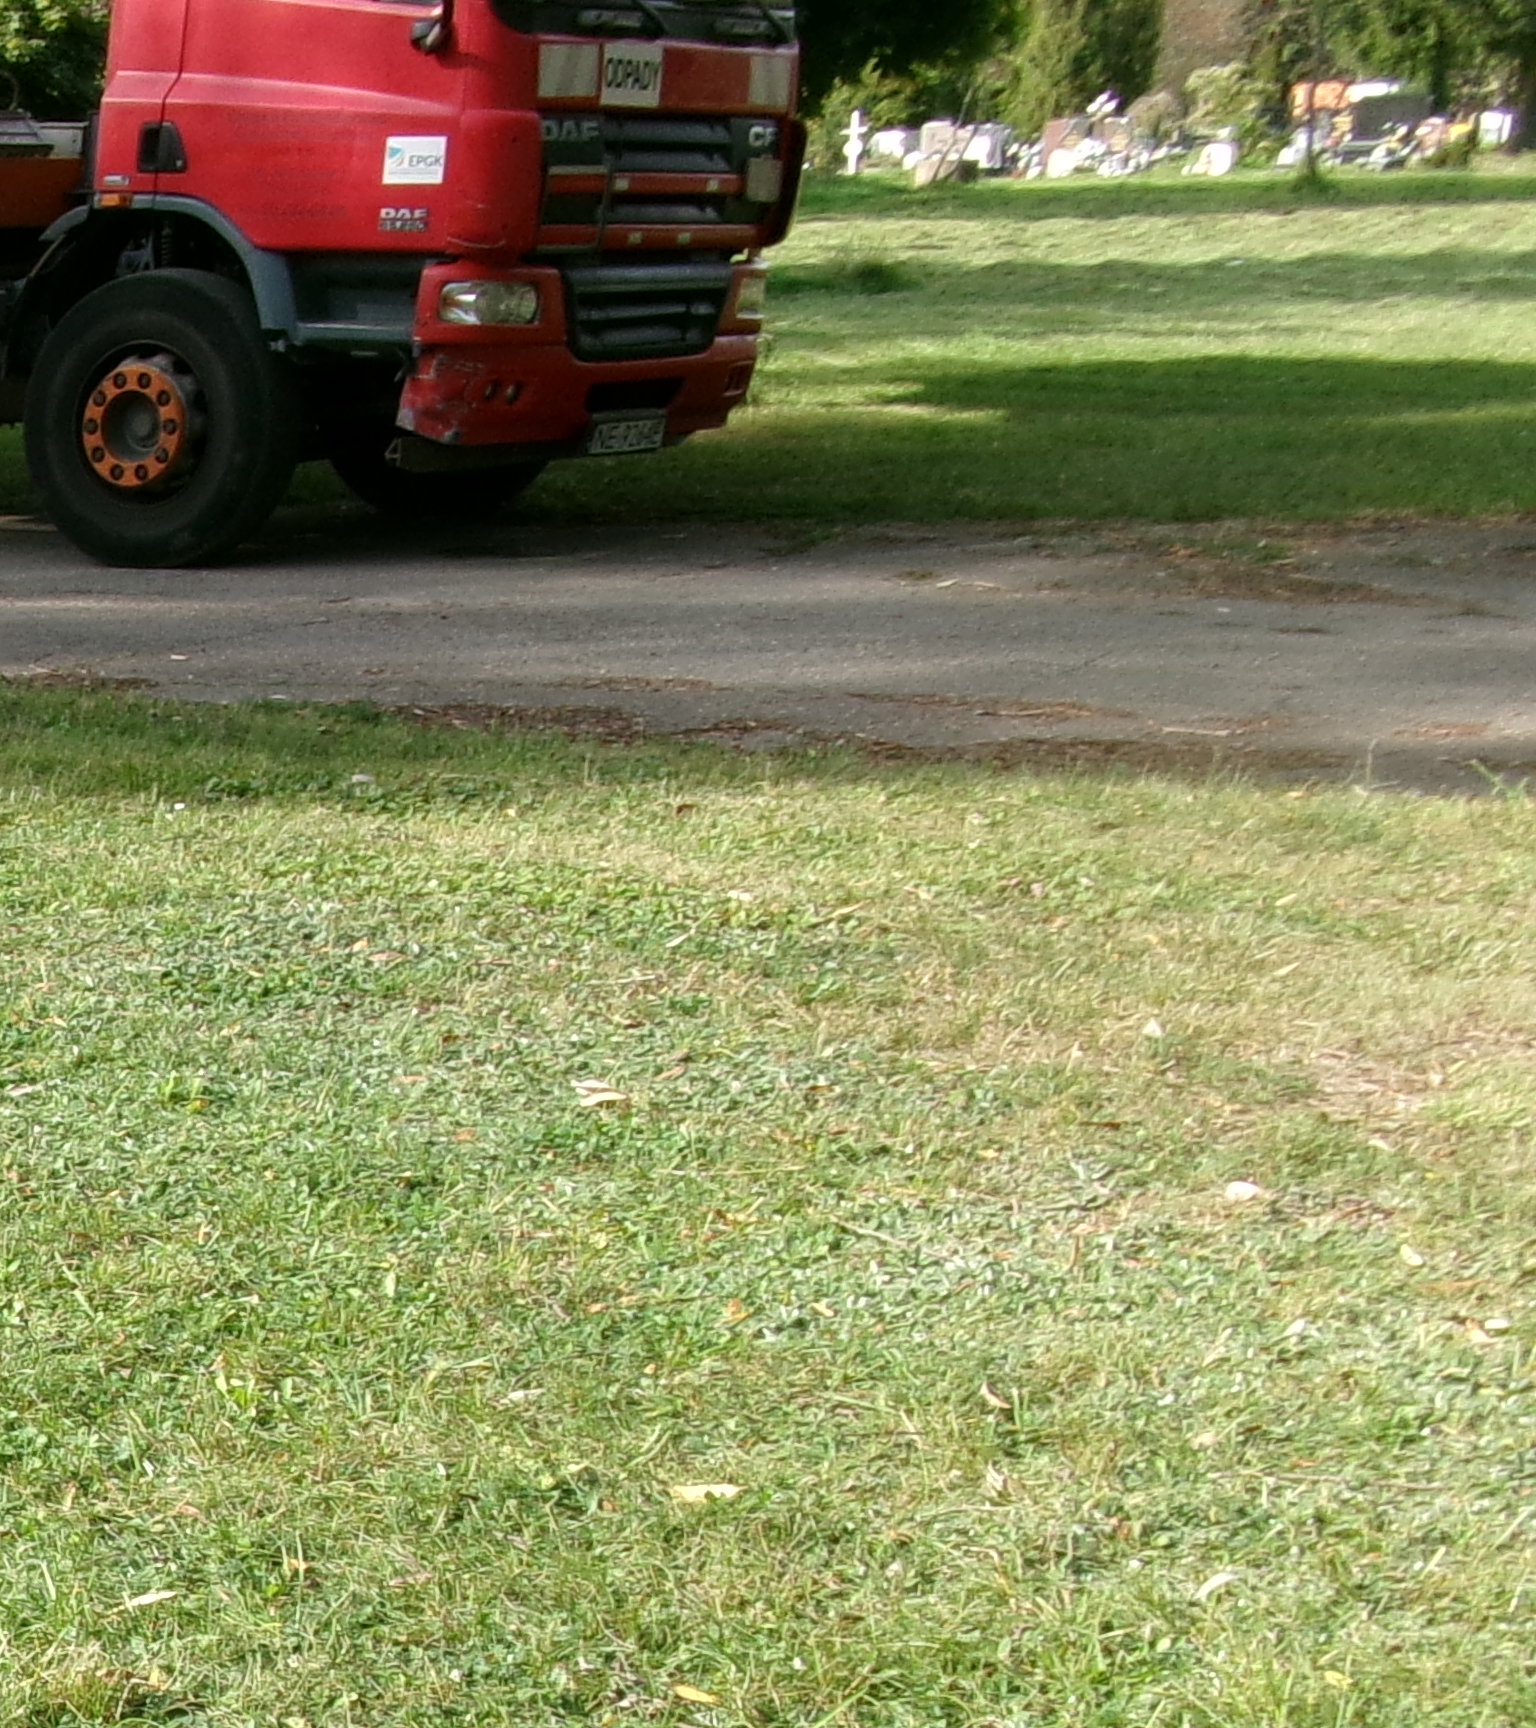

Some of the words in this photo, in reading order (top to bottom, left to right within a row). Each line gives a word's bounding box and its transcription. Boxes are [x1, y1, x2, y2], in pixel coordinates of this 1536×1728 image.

[606, 57, 662, 92] ODPADY
[540, 119, 600, 142] DAF
[748, 125, 777, 147] CF
[408, 154, 443, 168] EPGK
[379, 207, 427, 219] DAF
